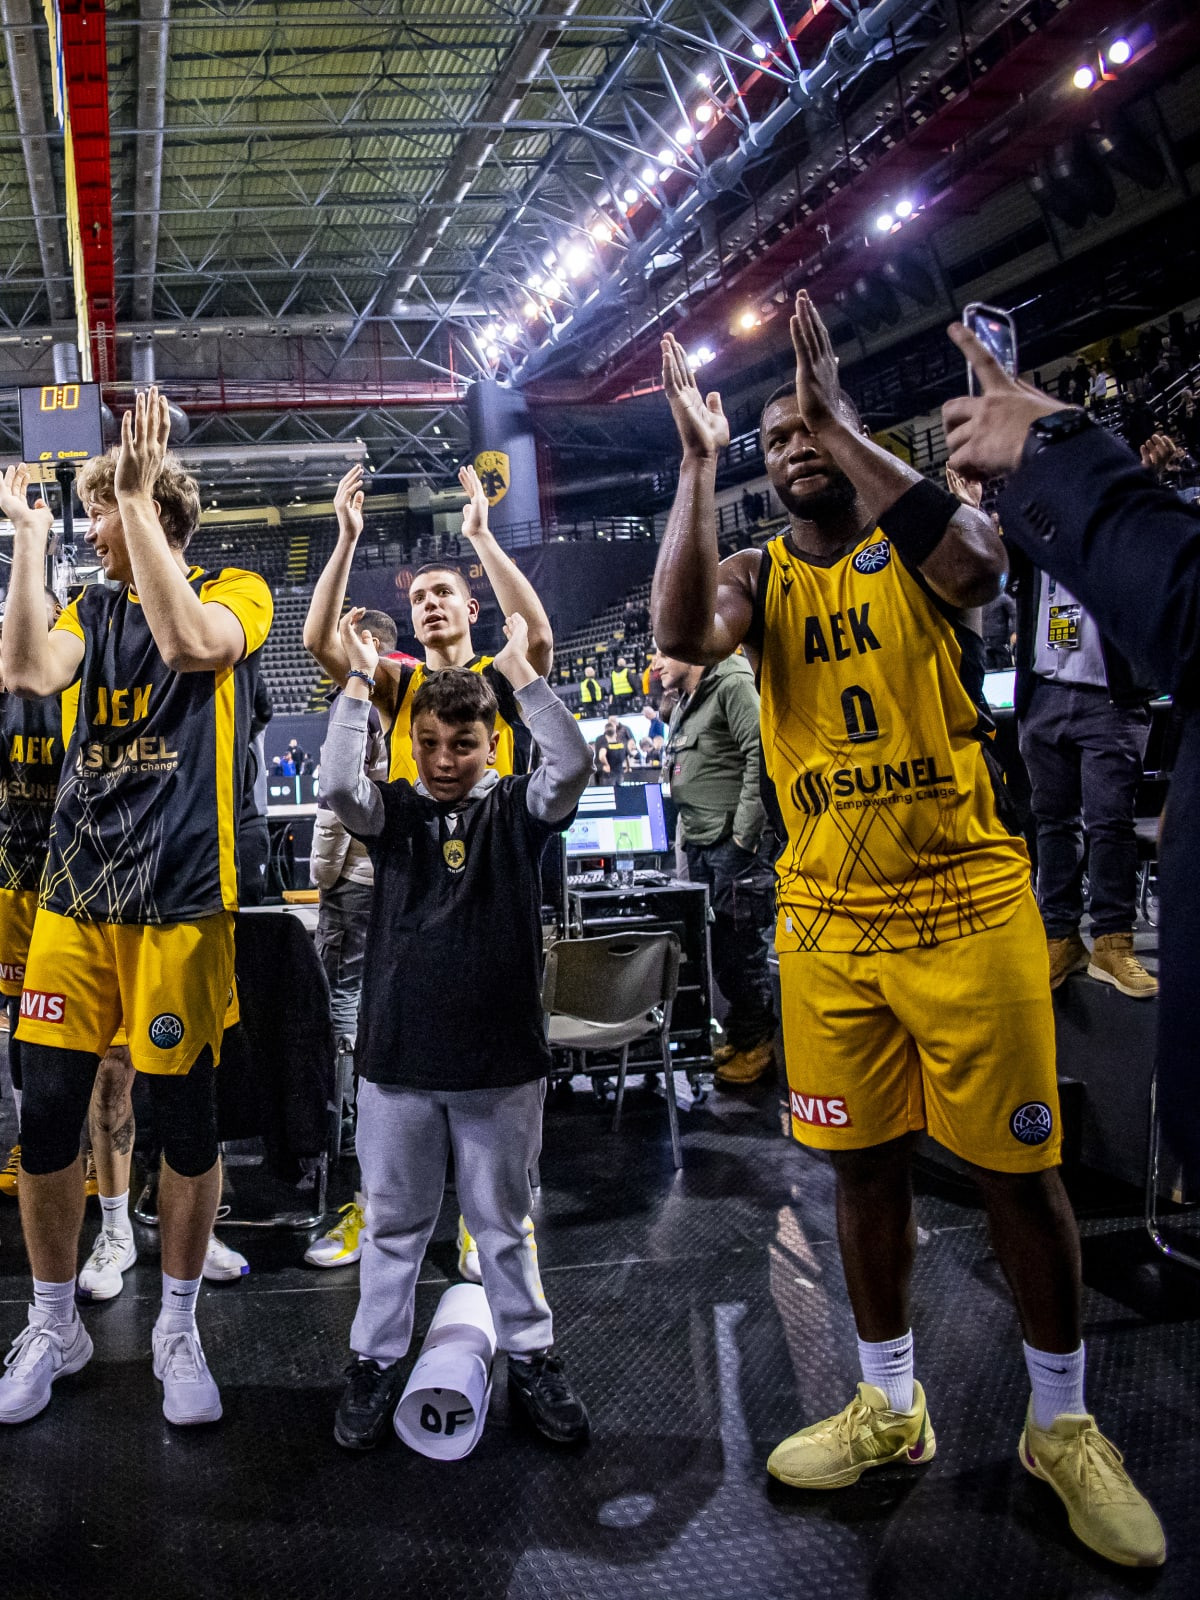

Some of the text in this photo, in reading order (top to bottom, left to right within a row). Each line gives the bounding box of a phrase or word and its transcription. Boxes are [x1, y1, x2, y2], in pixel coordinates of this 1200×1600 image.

[804, 602, 882, 664] AEK
[840, 684, 879, 744] 0
[10, 734, 55, 765] AEK
[85, 736, 178, 768] SUNEL
[140, 761, 178, 773] Change
[832, 756, 953, 797] SUNEL
[8, 780, 56, 799] SUNE
[836, 793, 913, 810] Empowering
[20, 991, 64, 1020] AVIS
[791, 1091, 848, 1125] AVIS
